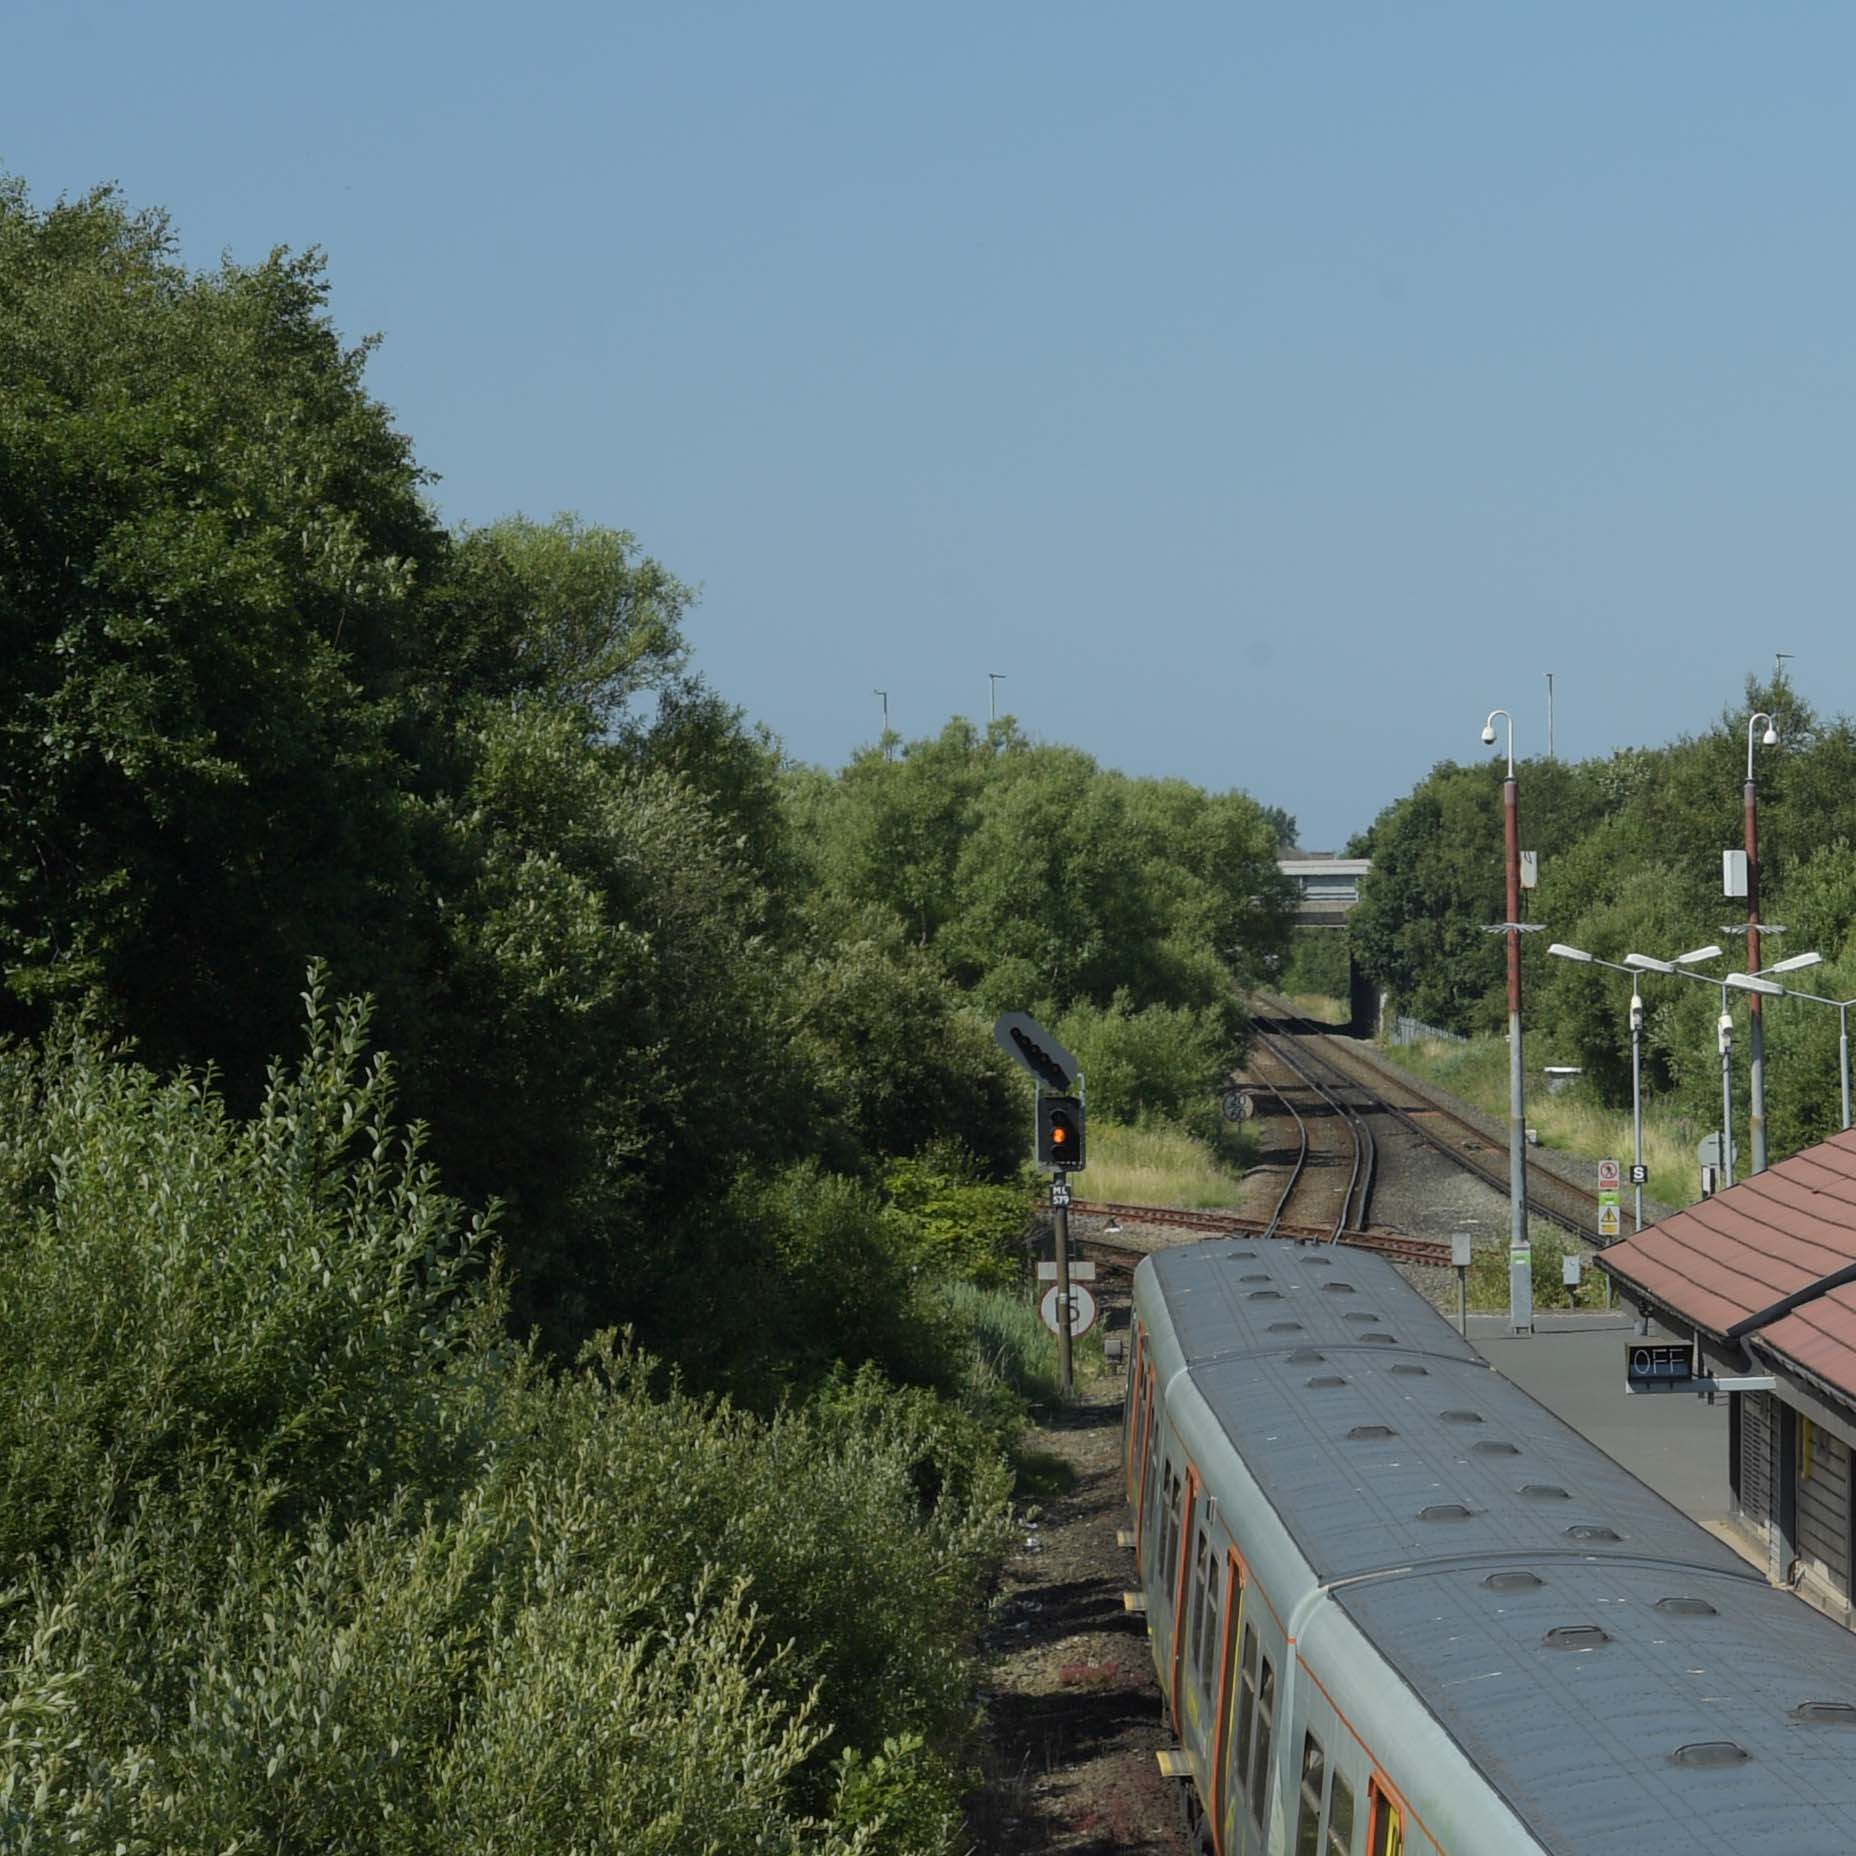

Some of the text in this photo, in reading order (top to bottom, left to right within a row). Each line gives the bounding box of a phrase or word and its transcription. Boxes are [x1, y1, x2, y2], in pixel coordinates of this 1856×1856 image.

[1633, 1166, 1644, 1180] S
[1052, 1185, 1067, 1196] ML
[1052, 1195, 1070, 1206] 579
[1634, 1349, 1685, 1375] OFF
